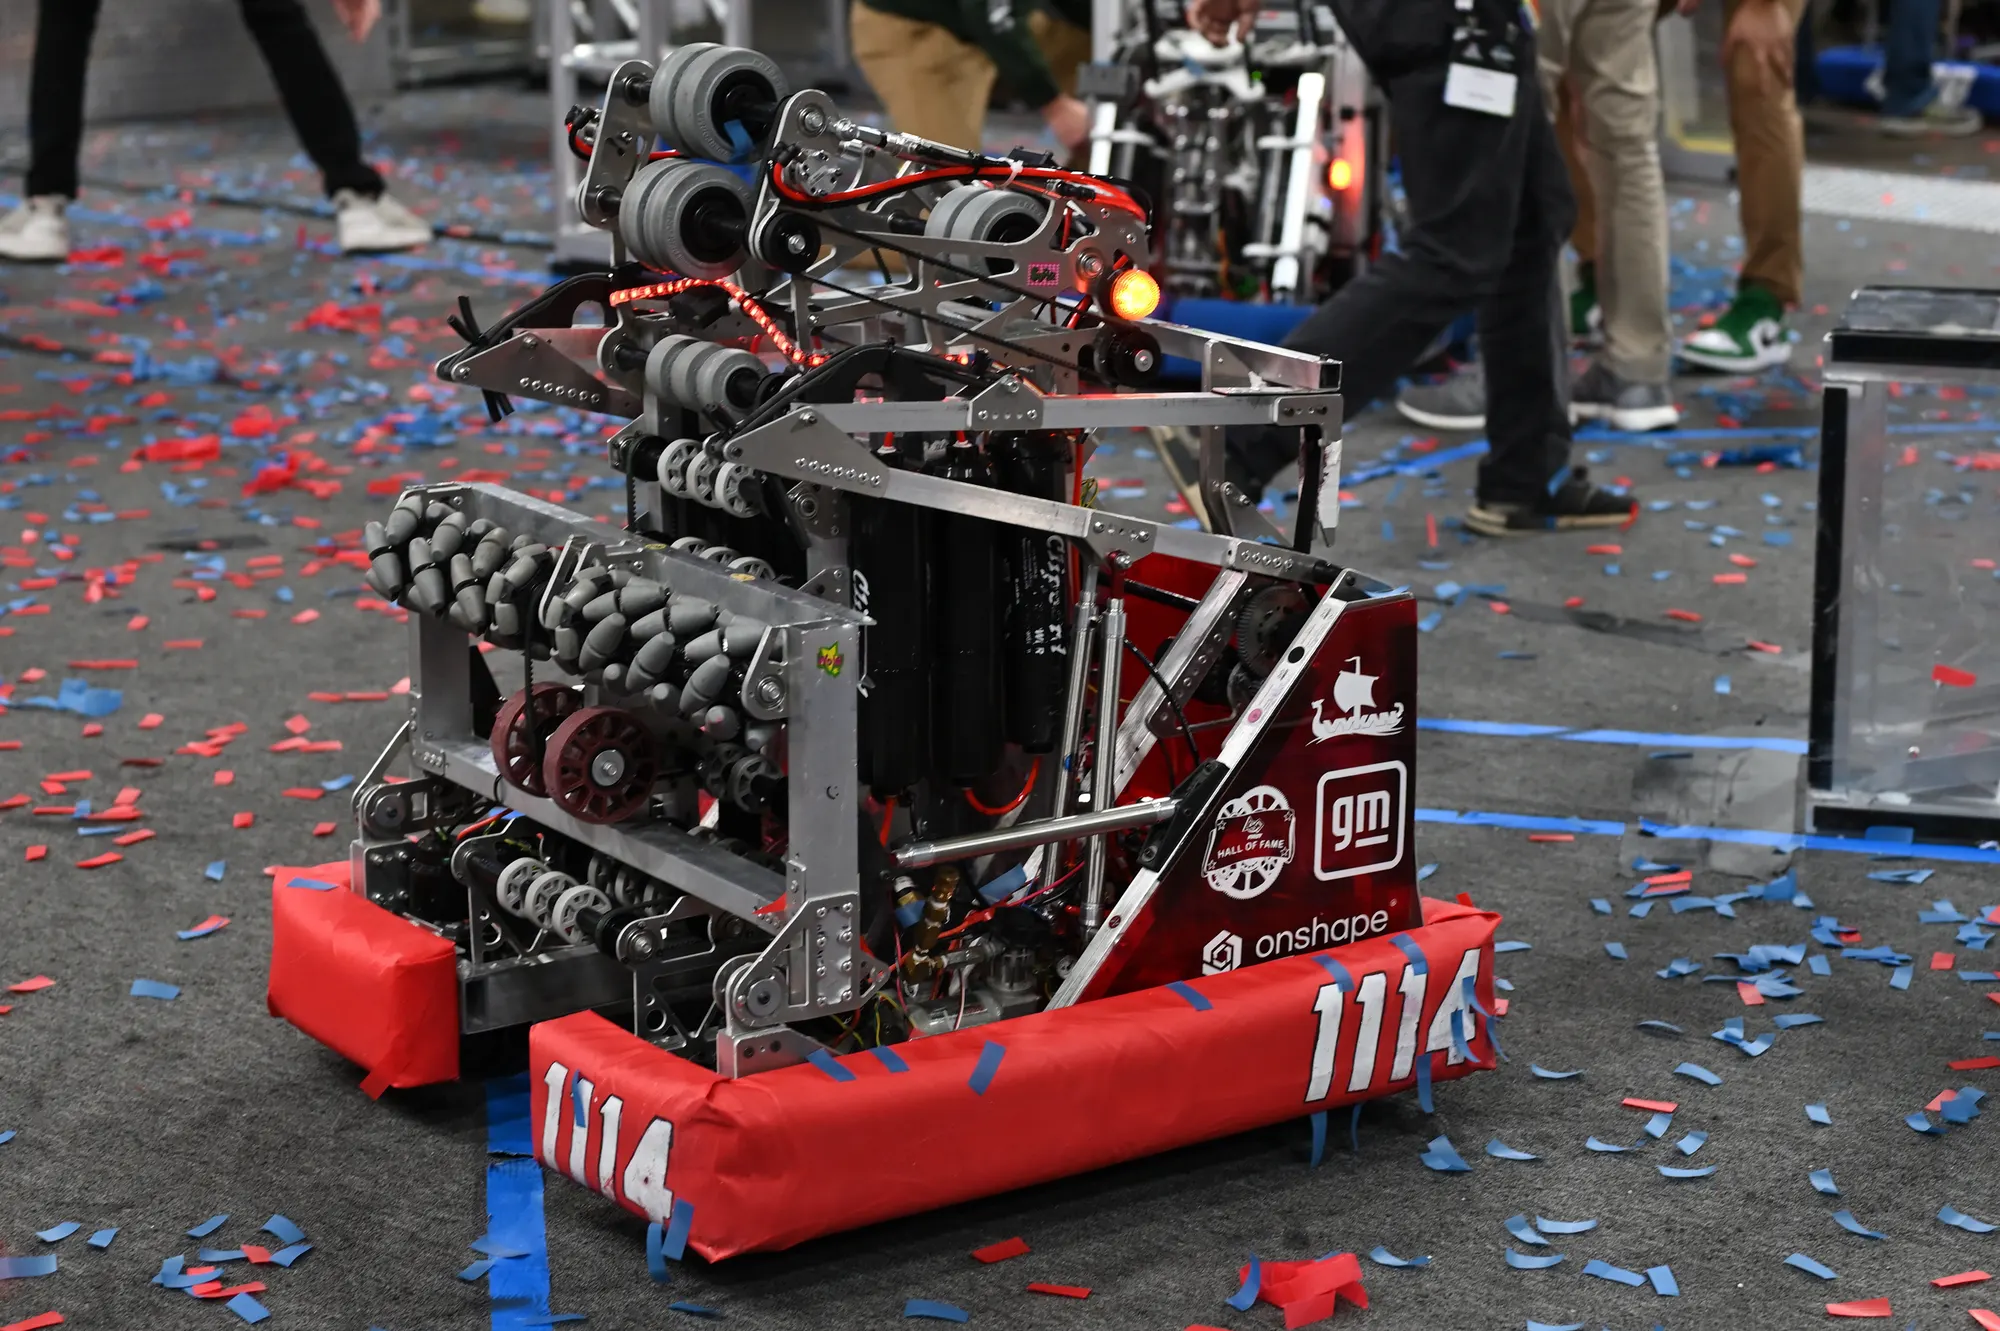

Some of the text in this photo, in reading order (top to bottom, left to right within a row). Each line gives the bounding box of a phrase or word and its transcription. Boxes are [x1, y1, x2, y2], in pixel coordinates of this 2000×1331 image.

[1217, 839, 1285, 859] HALL OF FAME
[1255, 908, 1389, 959] onshape
[1303, 947, 1482, 1103] 1114
[541, 1061, 675, 1225] 1114
